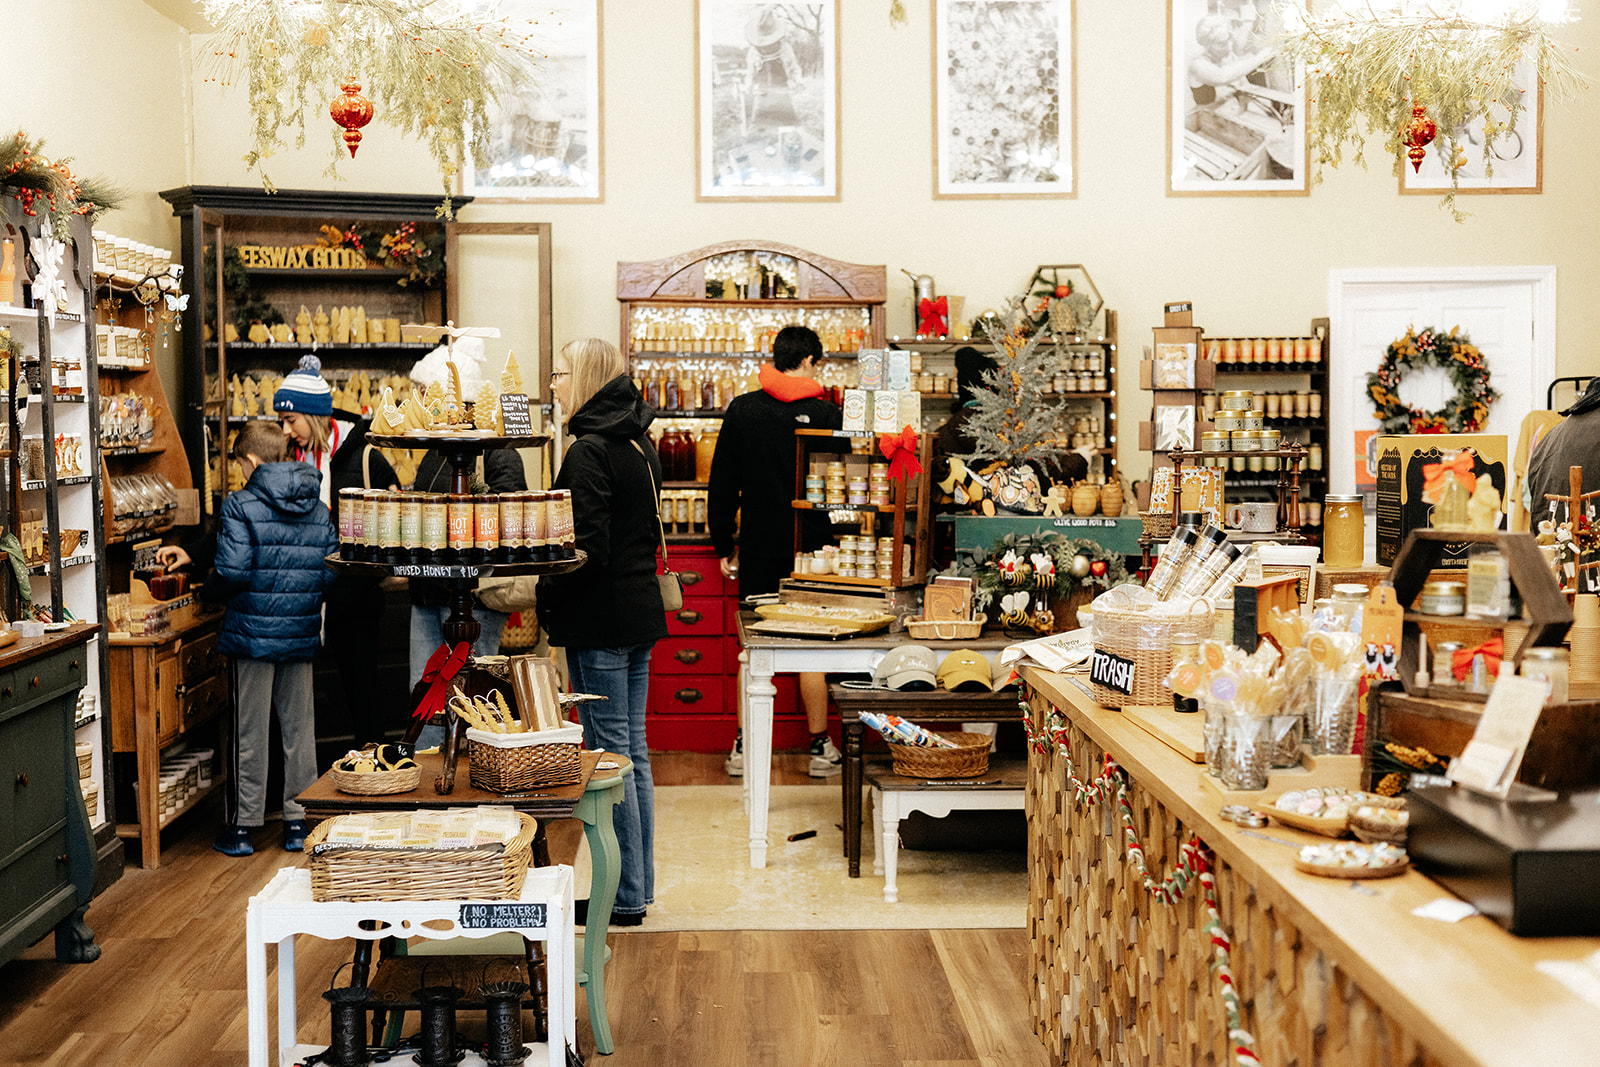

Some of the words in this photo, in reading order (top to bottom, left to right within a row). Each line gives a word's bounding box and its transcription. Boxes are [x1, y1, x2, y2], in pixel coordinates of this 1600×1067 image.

[238, 245, 309, 269] EESWAX
[312, 246, 367, 269] GOODS
[450, 517, 467, 530] HOT
[480, 518, 497, 530] HOT
[393, 565, 421, 577] INFUSED
[422, 565, 452, 577] HONEY
[460, 566, 479, 578] $16
[1093, 652, 1135, 691] TRASH
[472, 905, 488, 917] NO
[493, 905, 537, 917] MELTER?
[471, 918, 488, 928] NO
